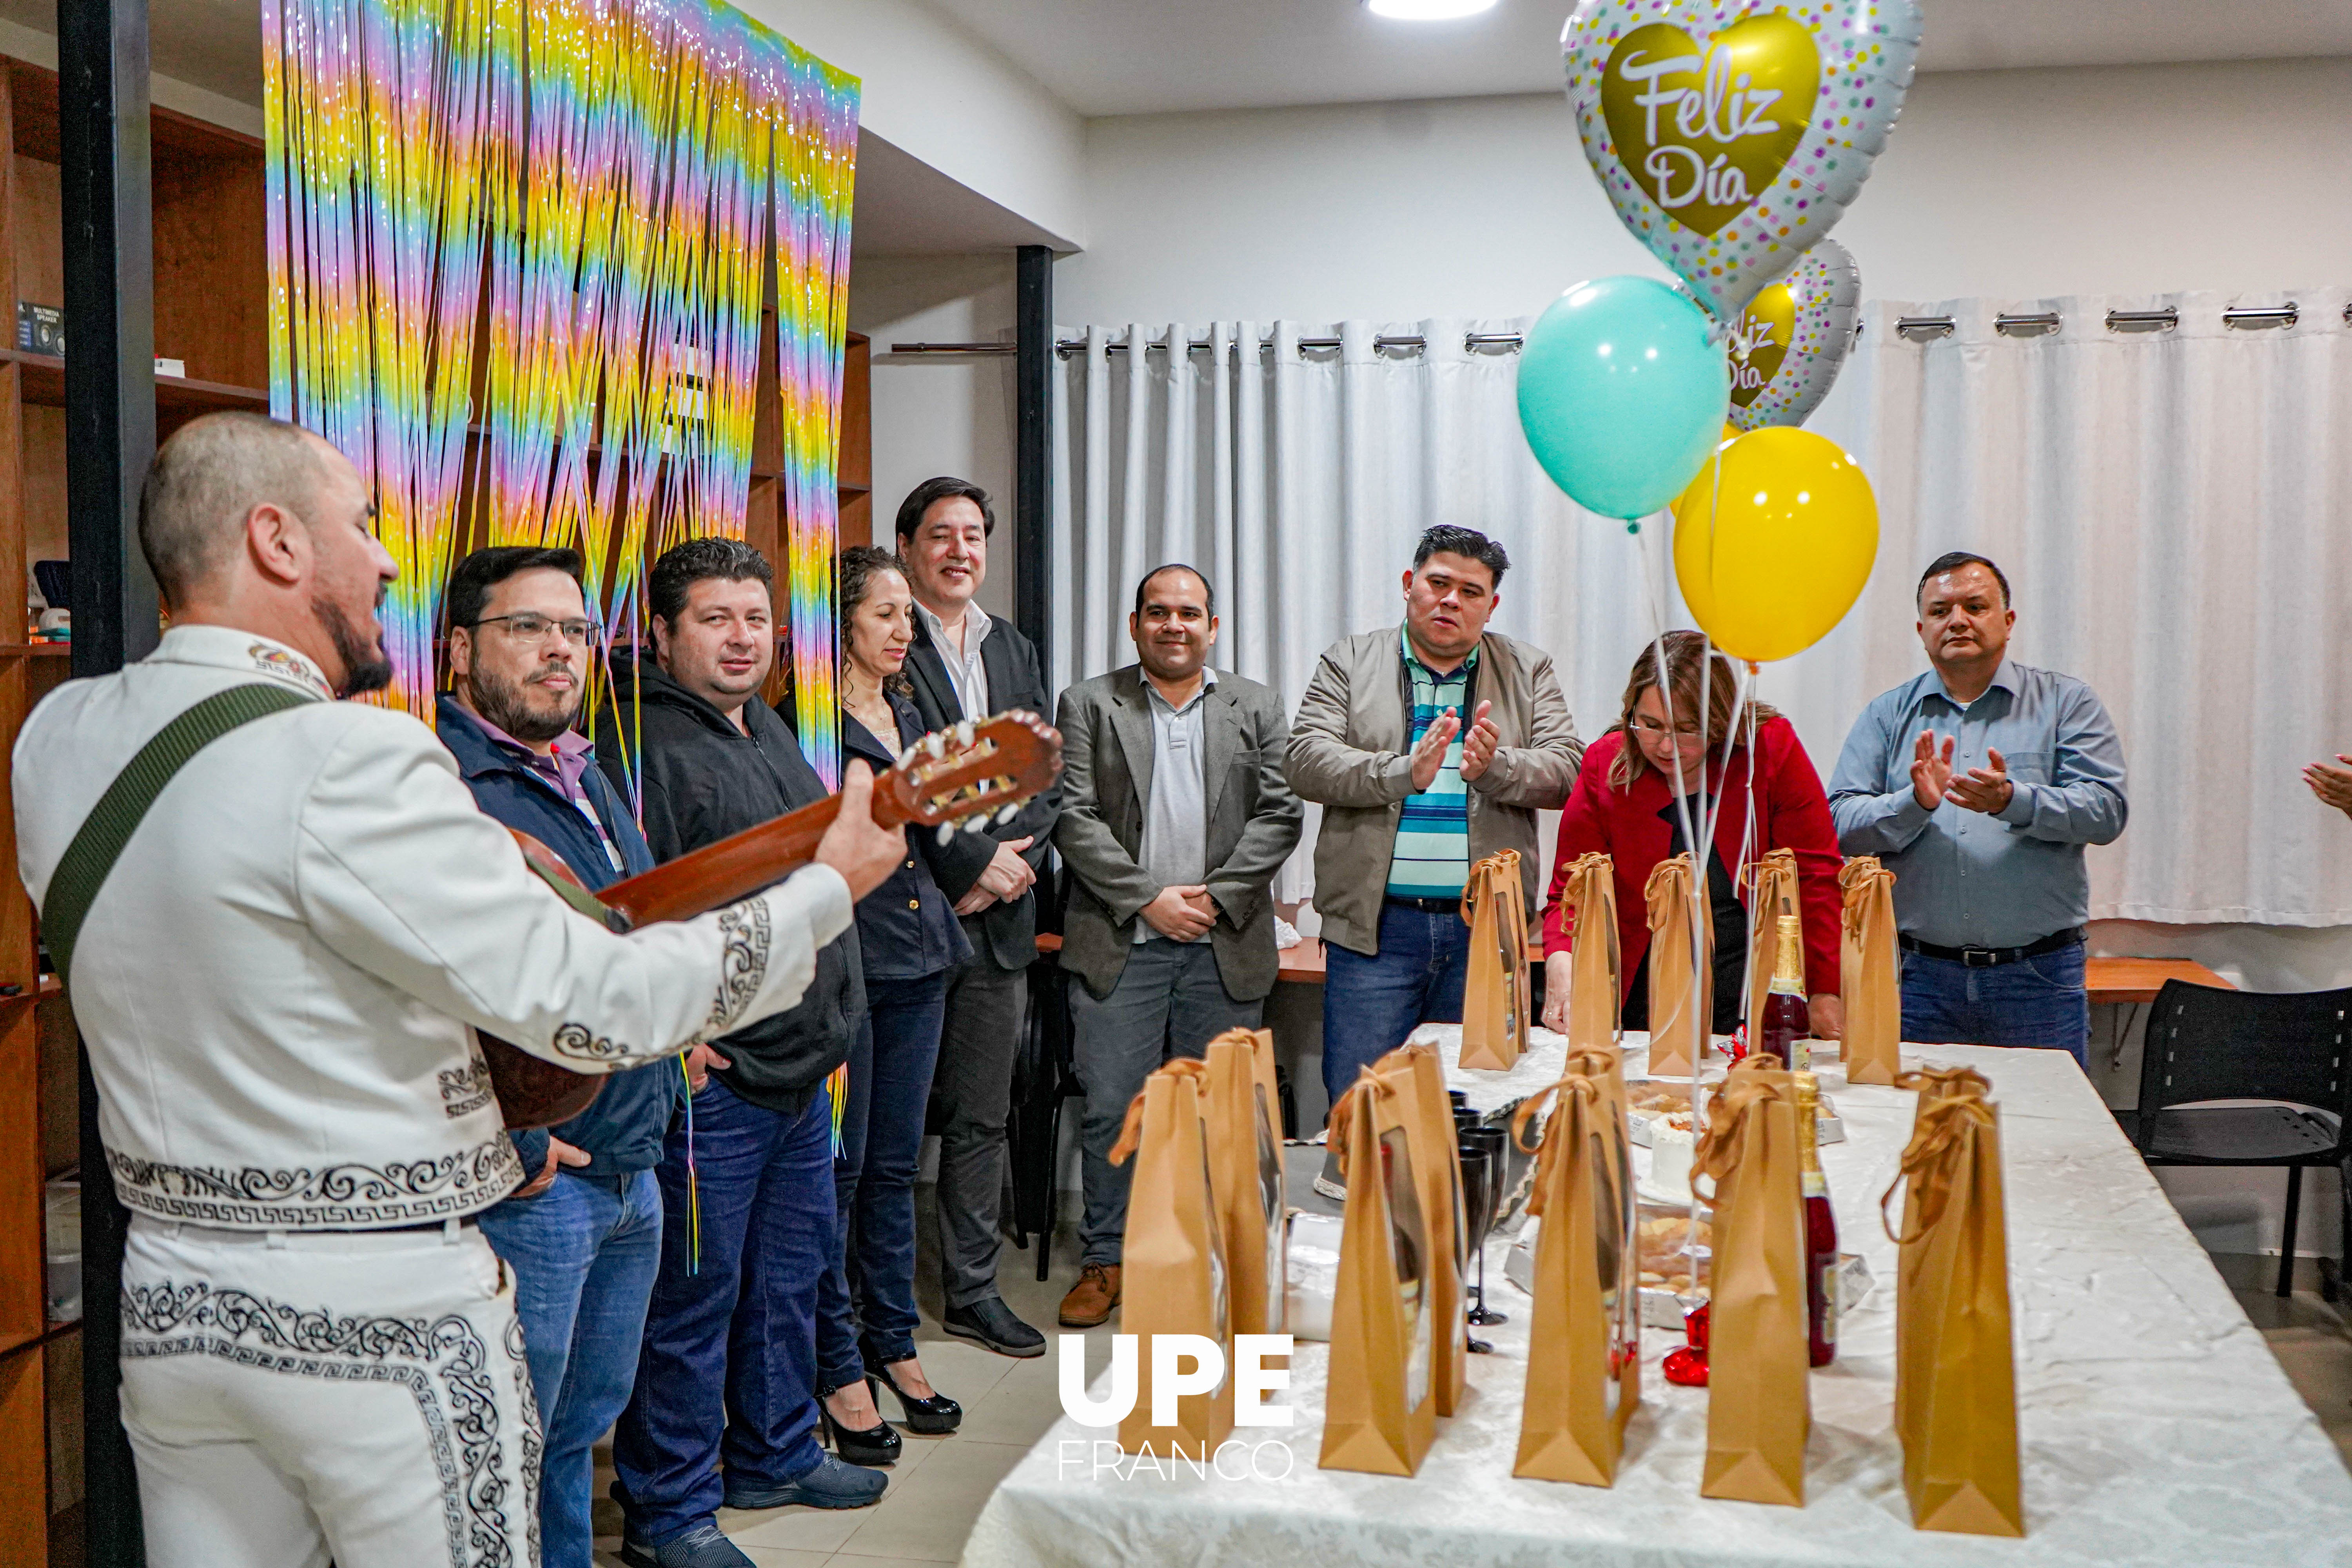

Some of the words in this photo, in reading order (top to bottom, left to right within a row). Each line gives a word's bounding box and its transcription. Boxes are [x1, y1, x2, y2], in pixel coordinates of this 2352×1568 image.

[1619, 44, 1783, 147] Feliz
[1644, 144, 1753, 209] Día
[33, 306, 60, 318] MULTIMEDIA
[36, 314, 57, 323] SPEAKER
[1727, 309, 1775, 353] liz
